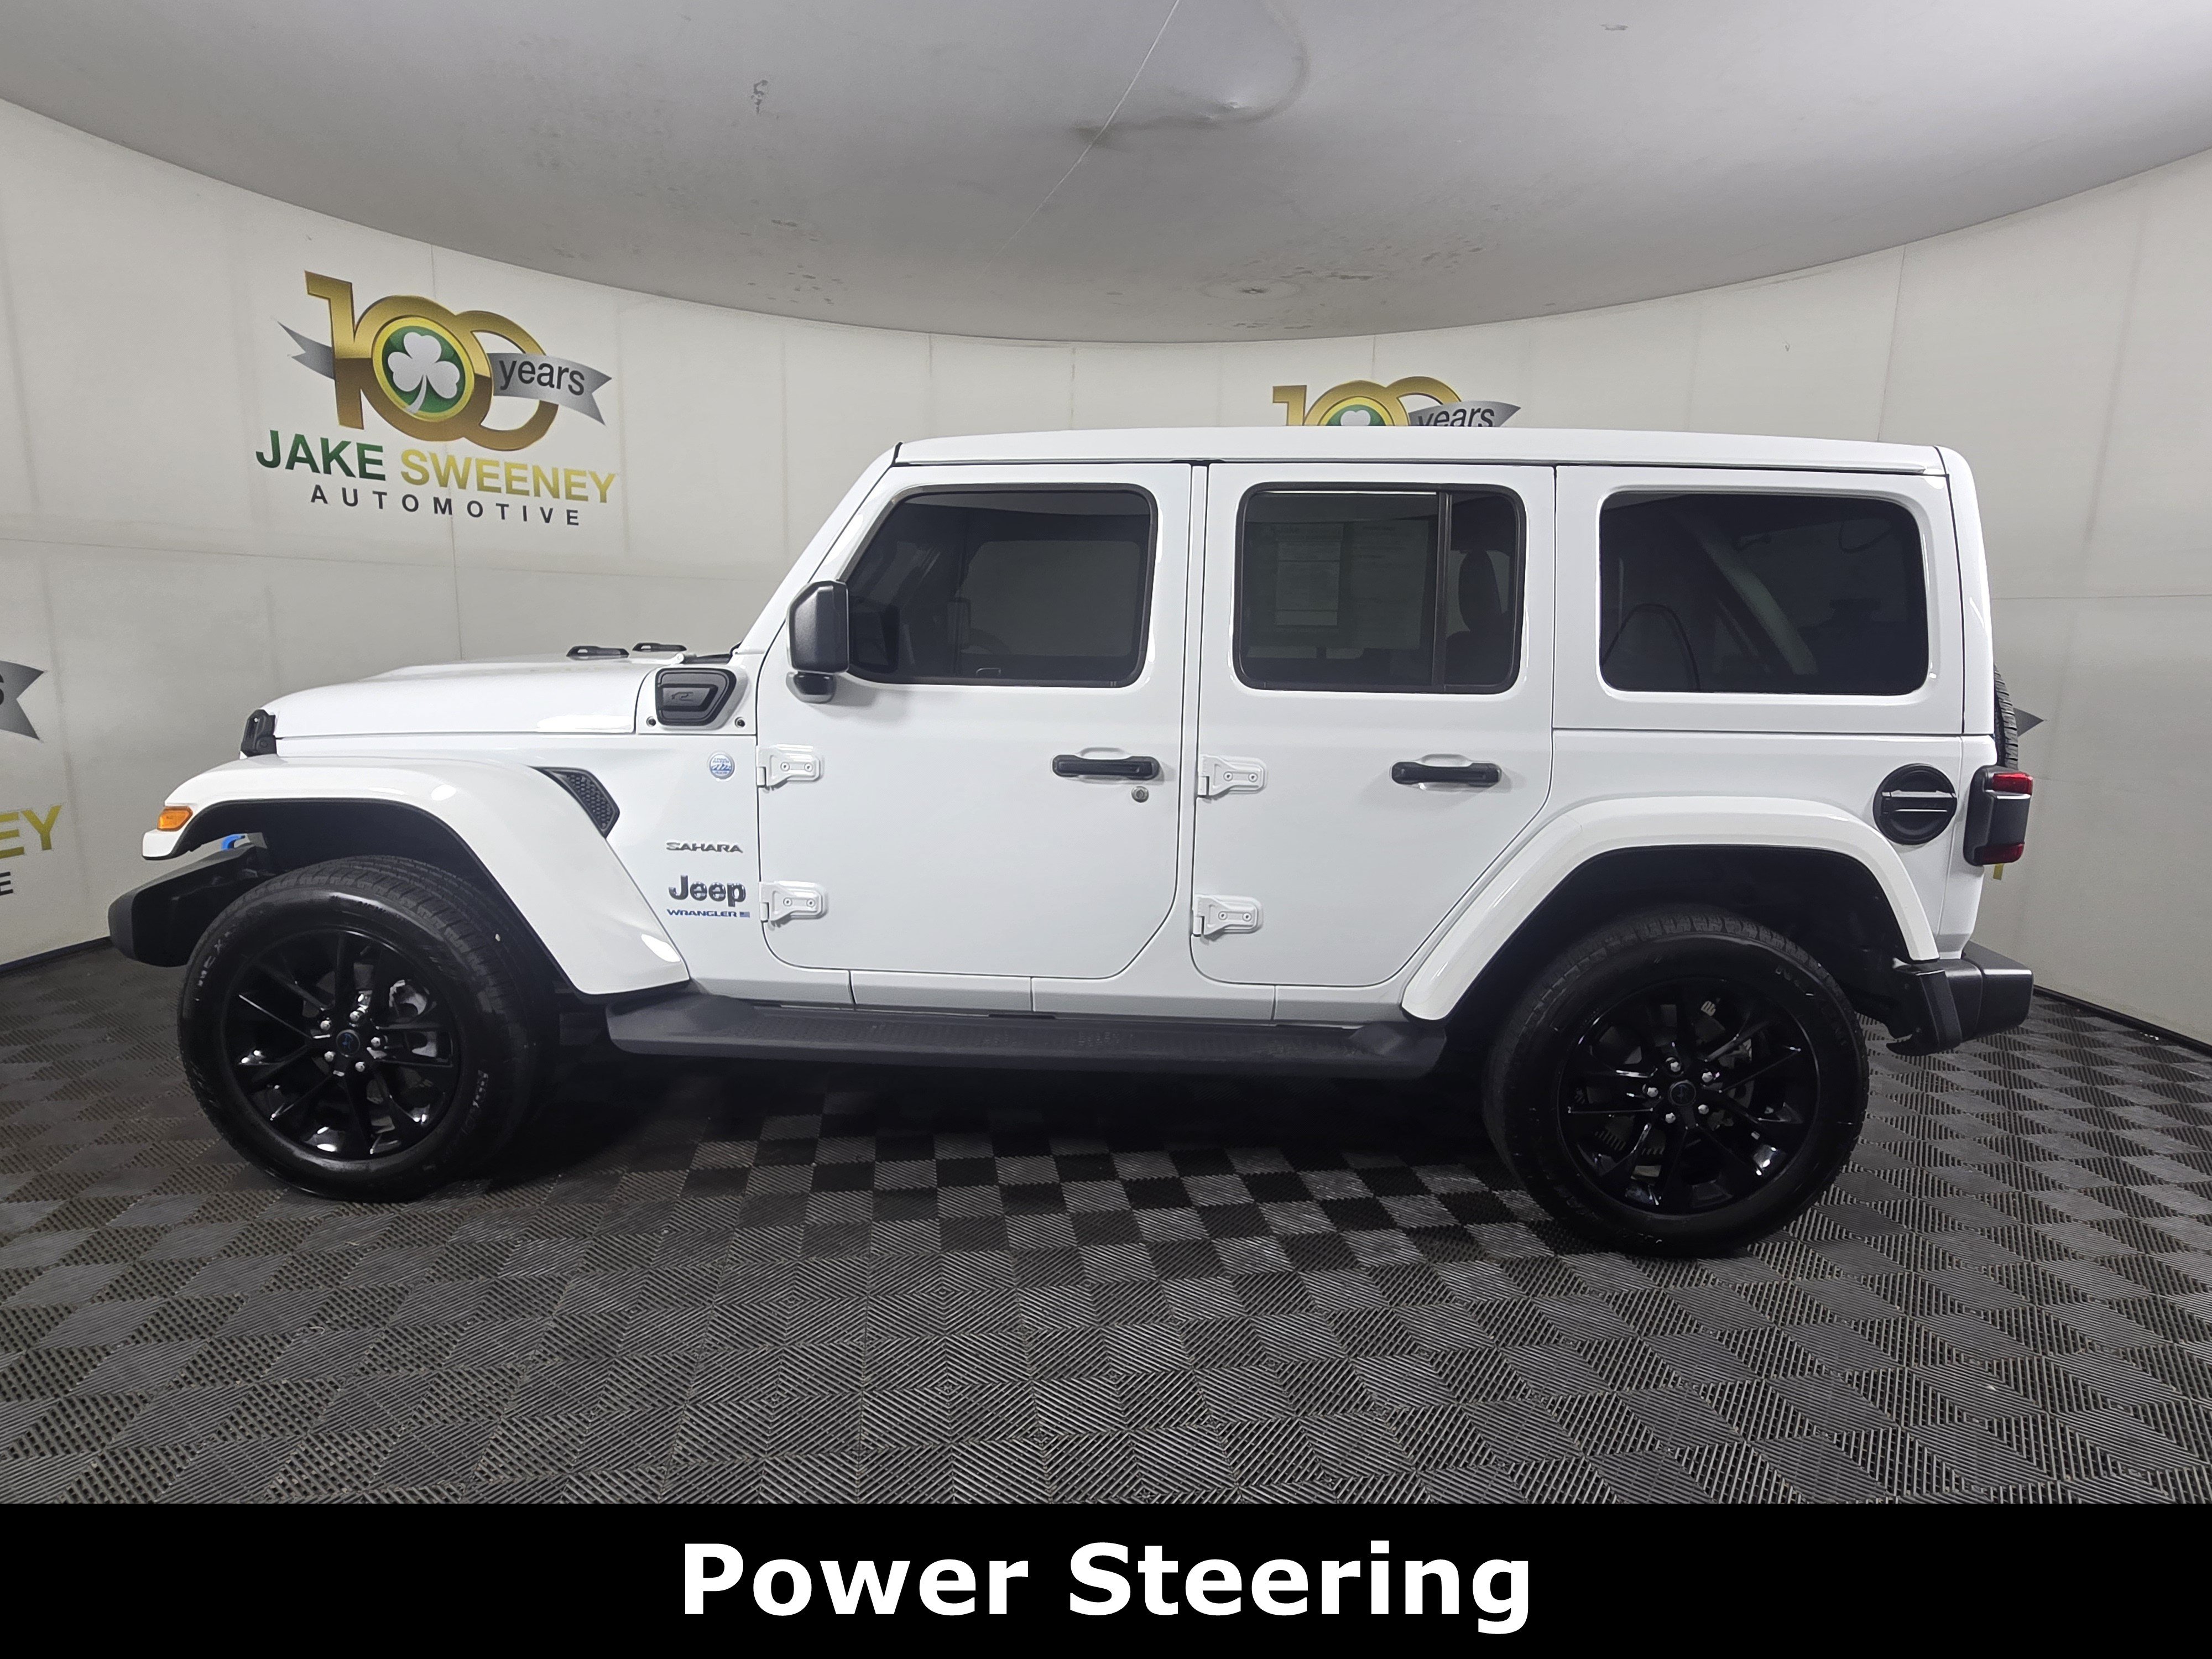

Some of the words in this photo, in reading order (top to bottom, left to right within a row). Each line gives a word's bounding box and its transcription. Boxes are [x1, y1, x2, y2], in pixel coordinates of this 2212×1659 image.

[498, 358, 586, 396] years
[255, 429, 386, 481] JAKE
[400, 449, 616, 503] SWEENEY
[310, 484, 580, 526] AUTOMOTIVE
[666, 842, 744, 853] SAHARA
[668, 875, 747, 907] Jeep
[666, 909, 737, 918] WRANGLER
